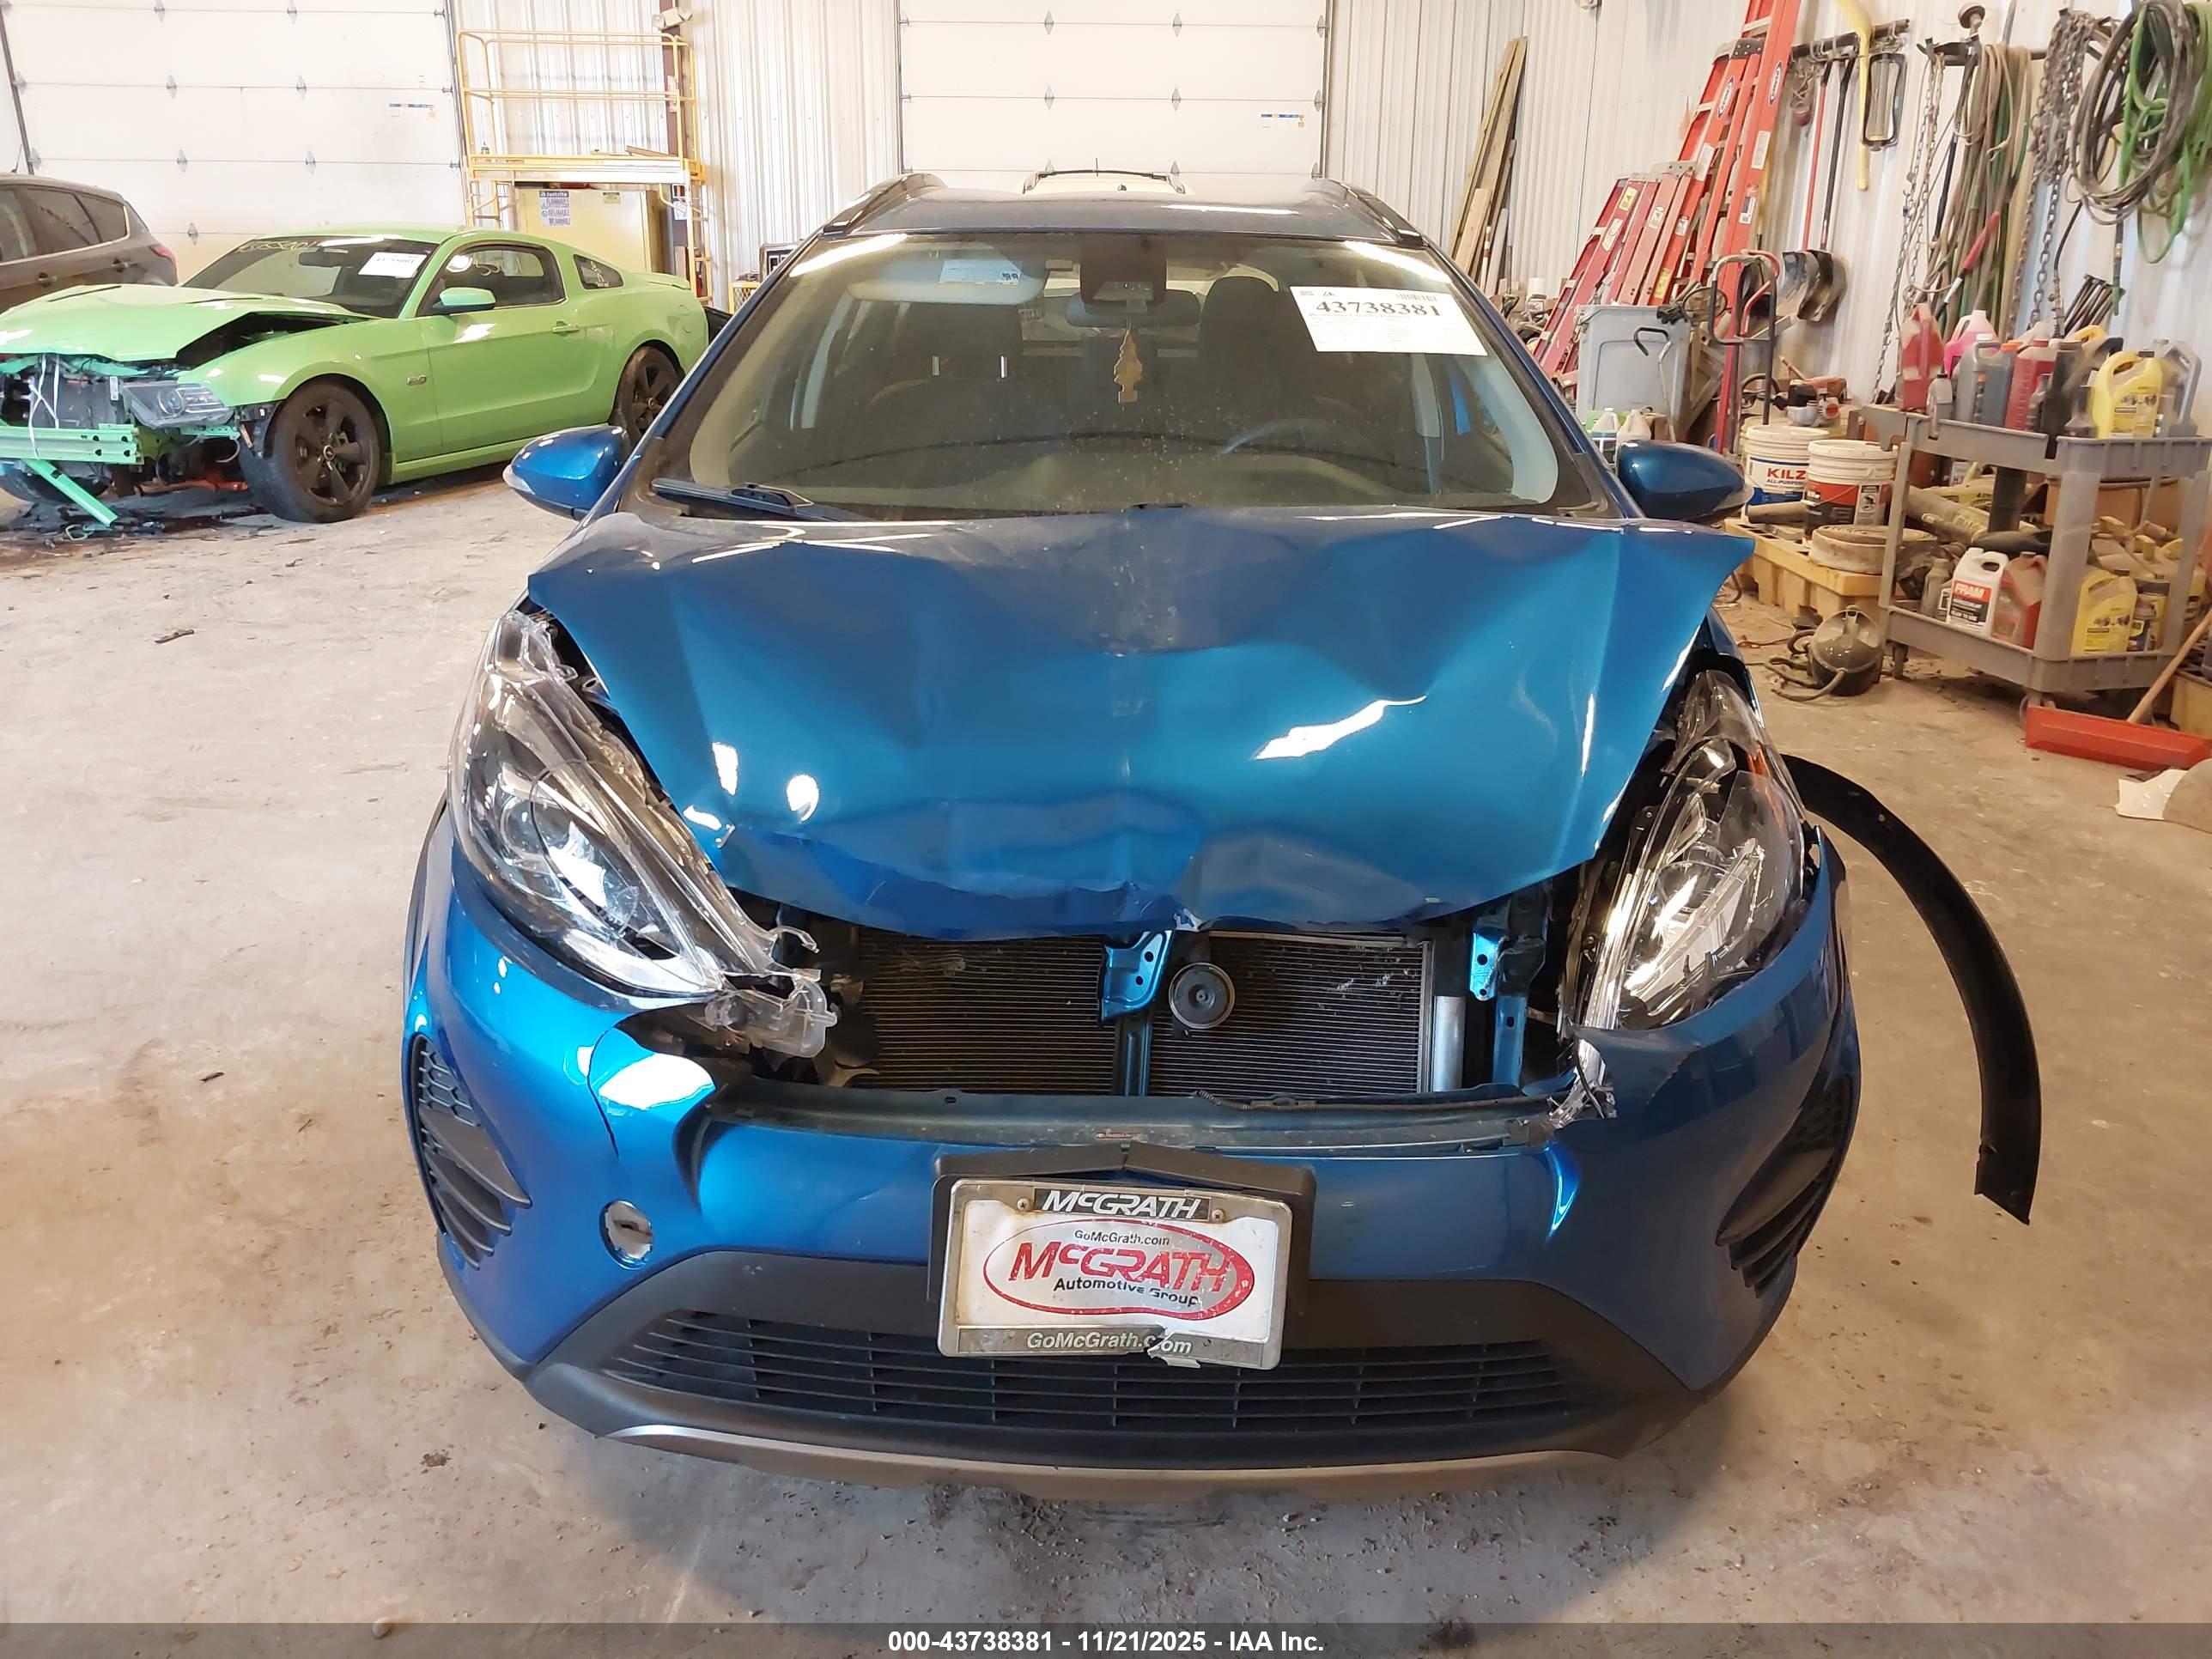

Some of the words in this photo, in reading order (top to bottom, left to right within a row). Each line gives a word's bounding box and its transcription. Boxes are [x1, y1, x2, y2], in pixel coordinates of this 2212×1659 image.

[1316, 301, 1442, 316] 43738381
[1767, 468, 1807, 480] KILZ
[1955, 583, 1984, 599] FRAM
[1074, 1230, 1170, 1246] GoMcGrath.com
[1053, 1277, 1145, 1294] Automotive
[1149, 1288, 1200, 1307] Group
[1027, 1331, 1193, 1354] GoMcGrath.com
